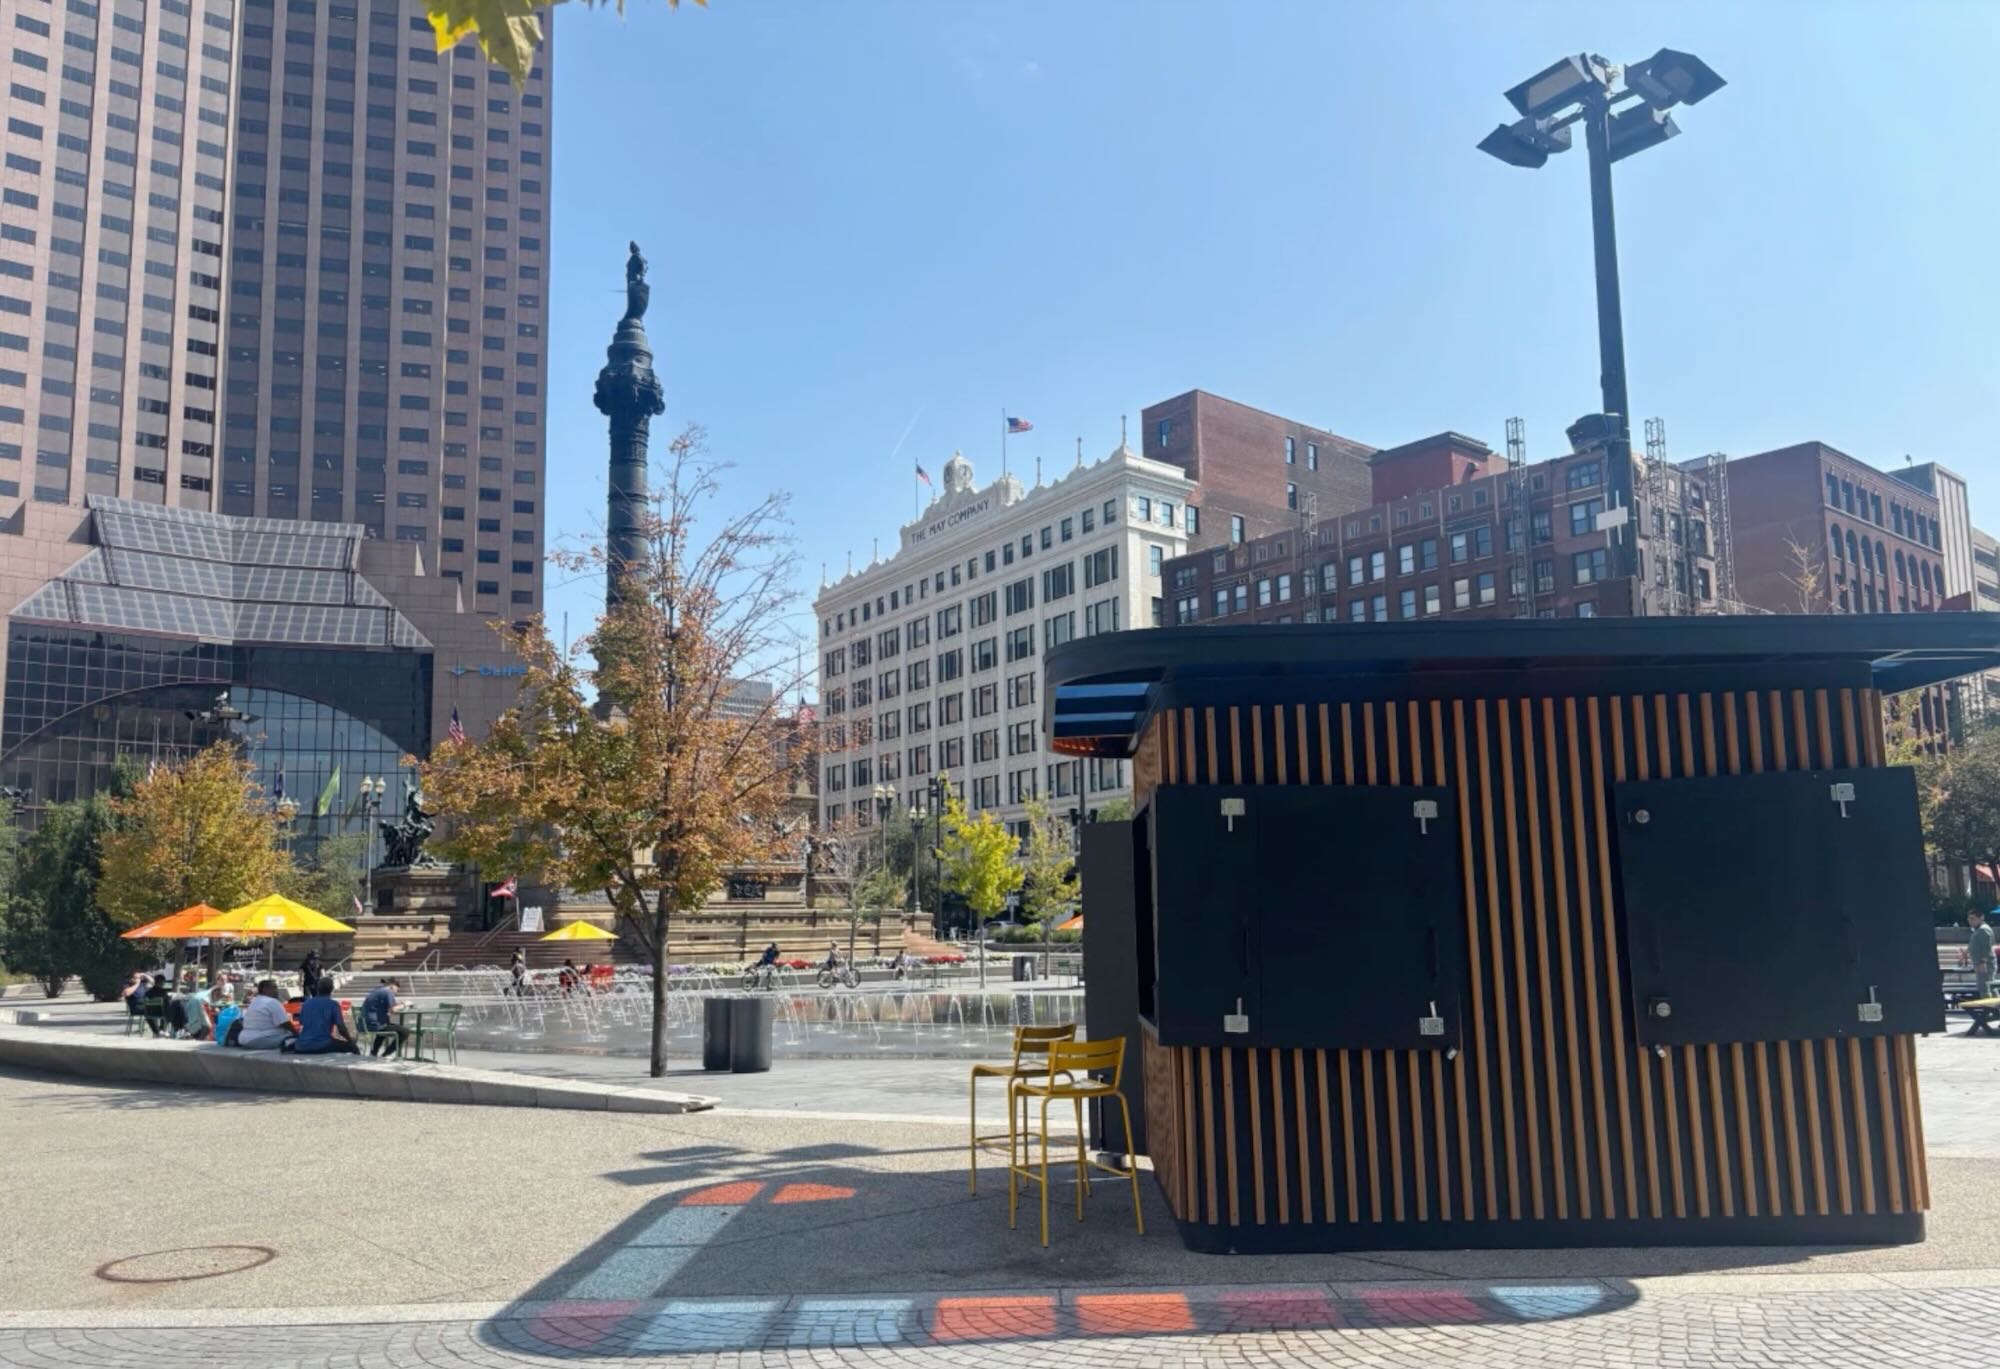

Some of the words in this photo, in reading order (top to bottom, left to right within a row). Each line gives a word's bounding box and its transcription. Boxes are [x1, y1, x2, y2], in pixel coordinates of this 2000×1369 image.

[911, 528, 926, 544] THE
[929, 519, 946, 536] MAY
[947, 499, 989, 527] COMPANY
